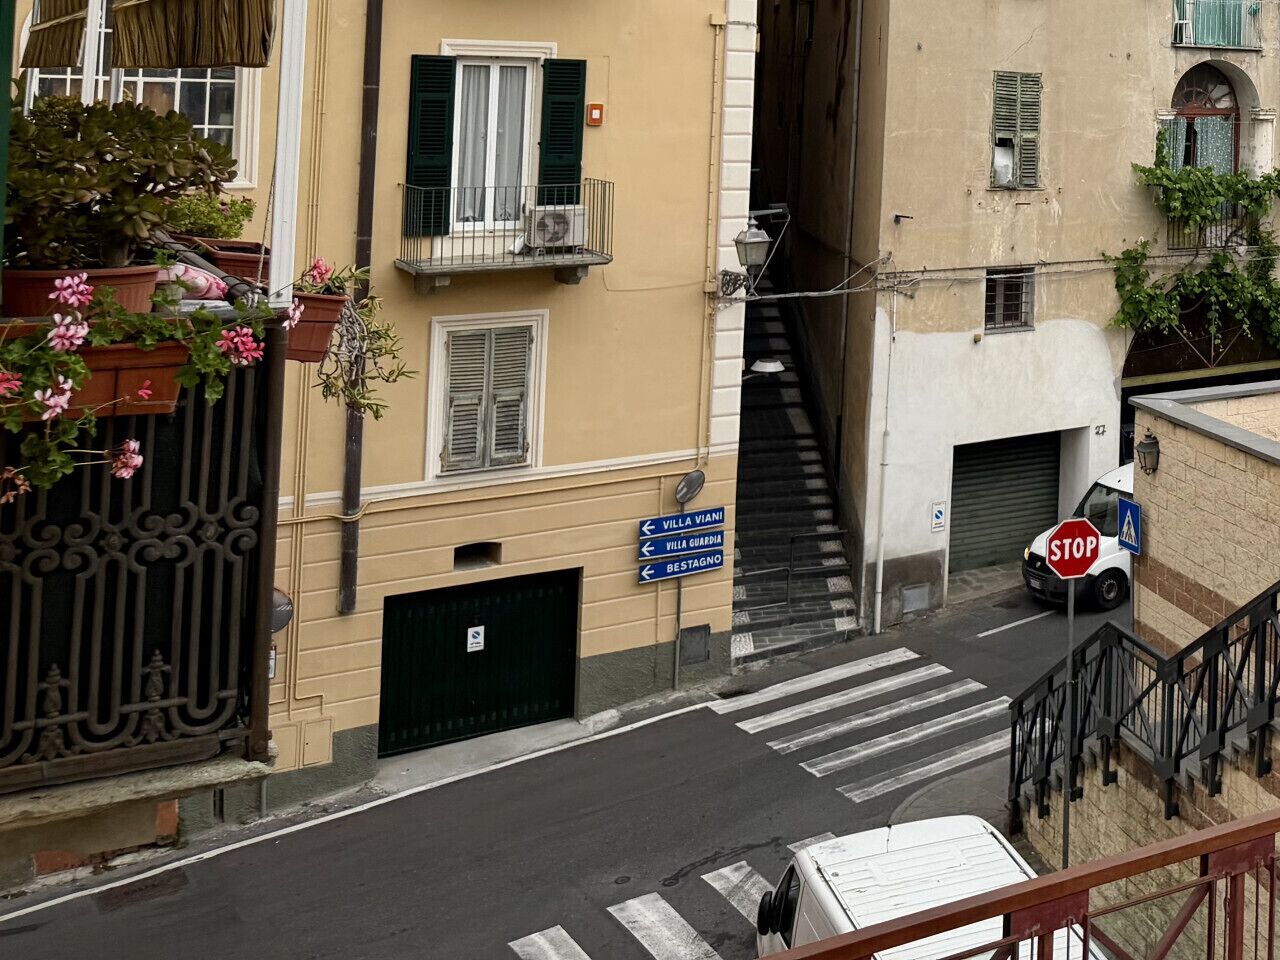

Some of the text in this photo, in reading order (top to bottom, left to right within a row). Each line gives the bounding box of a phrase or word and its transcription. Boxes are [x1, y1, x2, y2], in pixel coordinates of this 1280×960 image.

[1095, 425, 1106, 435] 27
[663, 512, 723, 530] VILLA VIANI
[666, 535, 722, 551] VILLA GUARDIA
[1050, 536, 1097, 561] STOP
[666, 554, 722, 573] BESTAGNO
